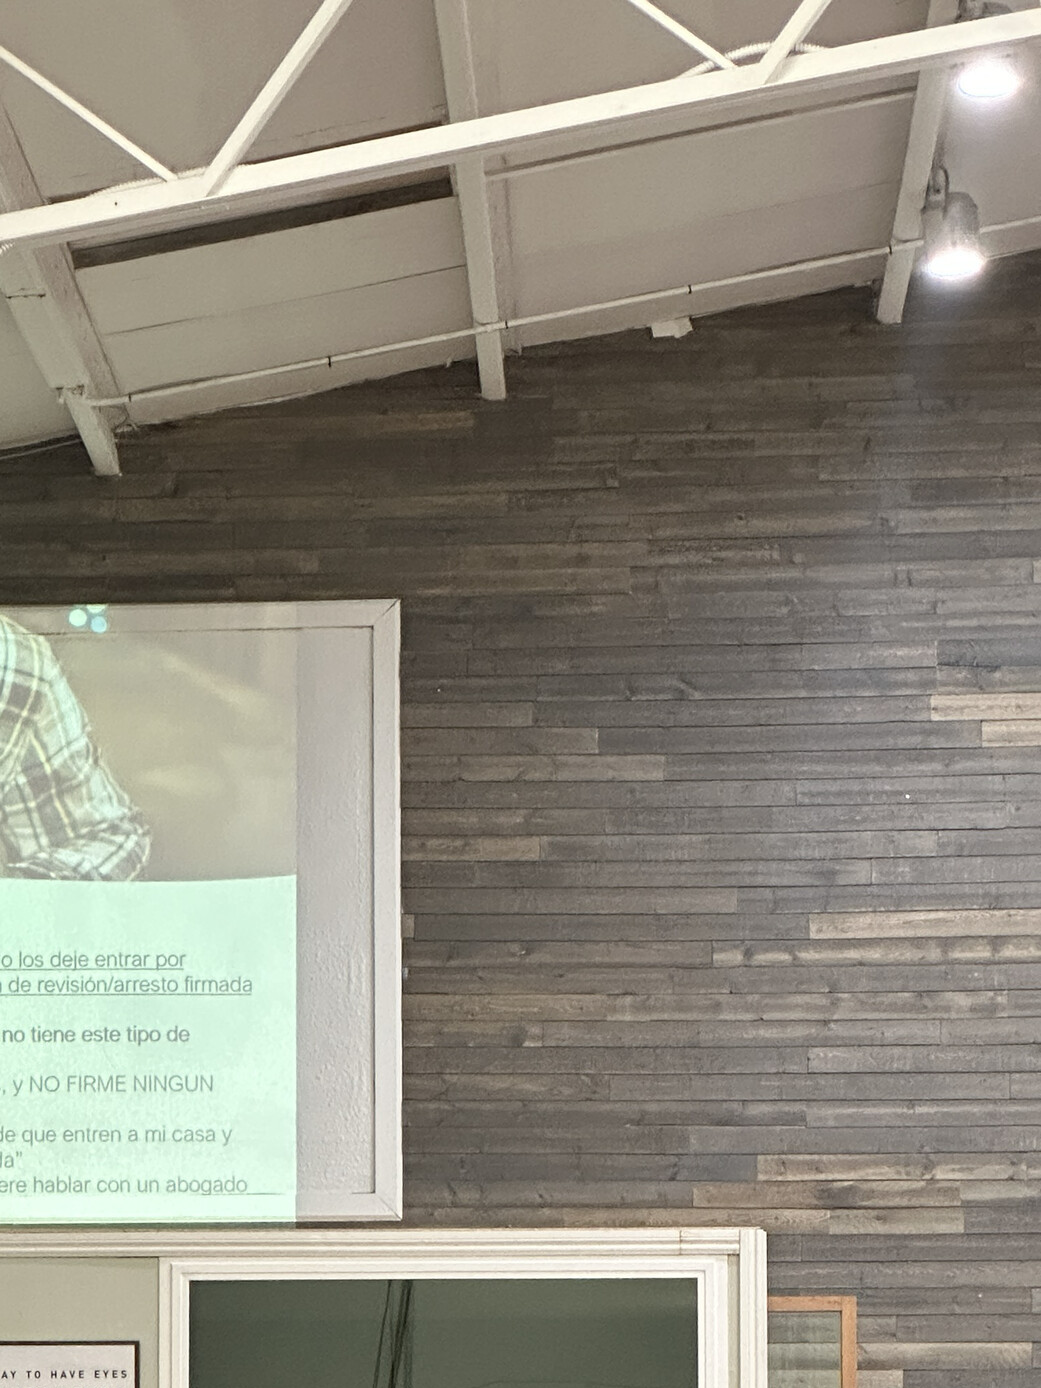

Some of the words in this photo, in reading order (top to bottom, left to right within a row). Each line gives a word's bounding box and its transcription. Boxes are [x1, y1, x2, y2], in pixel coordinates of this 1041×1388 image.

[18, 950, 44, 968] los
[50, 950, 88, 970] deje
[95, 952, 150, 967] entrar
[156, 954, 186, 971] por
[8, 976, 31, 993] de
[38, 975, 178, 993] revisión/arresto
[185, 975, 252, 993] firmada
[2, 1029, 25, 1042] no
[31, 1026, 75, 1042] tiene
[82, 1027, 121, 1042] este
[126, 1026, 161, 1046] tipo
[166, 1026, 190, 1042] de
[13, 1079, 23, 1096] y
[30, 1075, 60, 1093] NO
[67, 1075, 126, 1092] FIRME
[133, 1075, 214, 1092] NINGUN
[22, 1129, 57, 1146] que
[63, 1127, 121, 1142] entren
[128, 1130, 138, 1142] a
[145, 1125, 166, 1142] mi
[172, 1128, 216, 1142] casa
[222, 1128, 232, 1146] y
[34, 1176, 91, 1193] hablar
[97, 1179, 130, 1193] con
[137, 1179, 159, 1192] un
[166, 1176, 248, 1196] abogado
[26, 1370, 41, 1379] TO
[50, 1370, 85, 1379] HAVE
[94, 1370, 128, 1379] EYES
